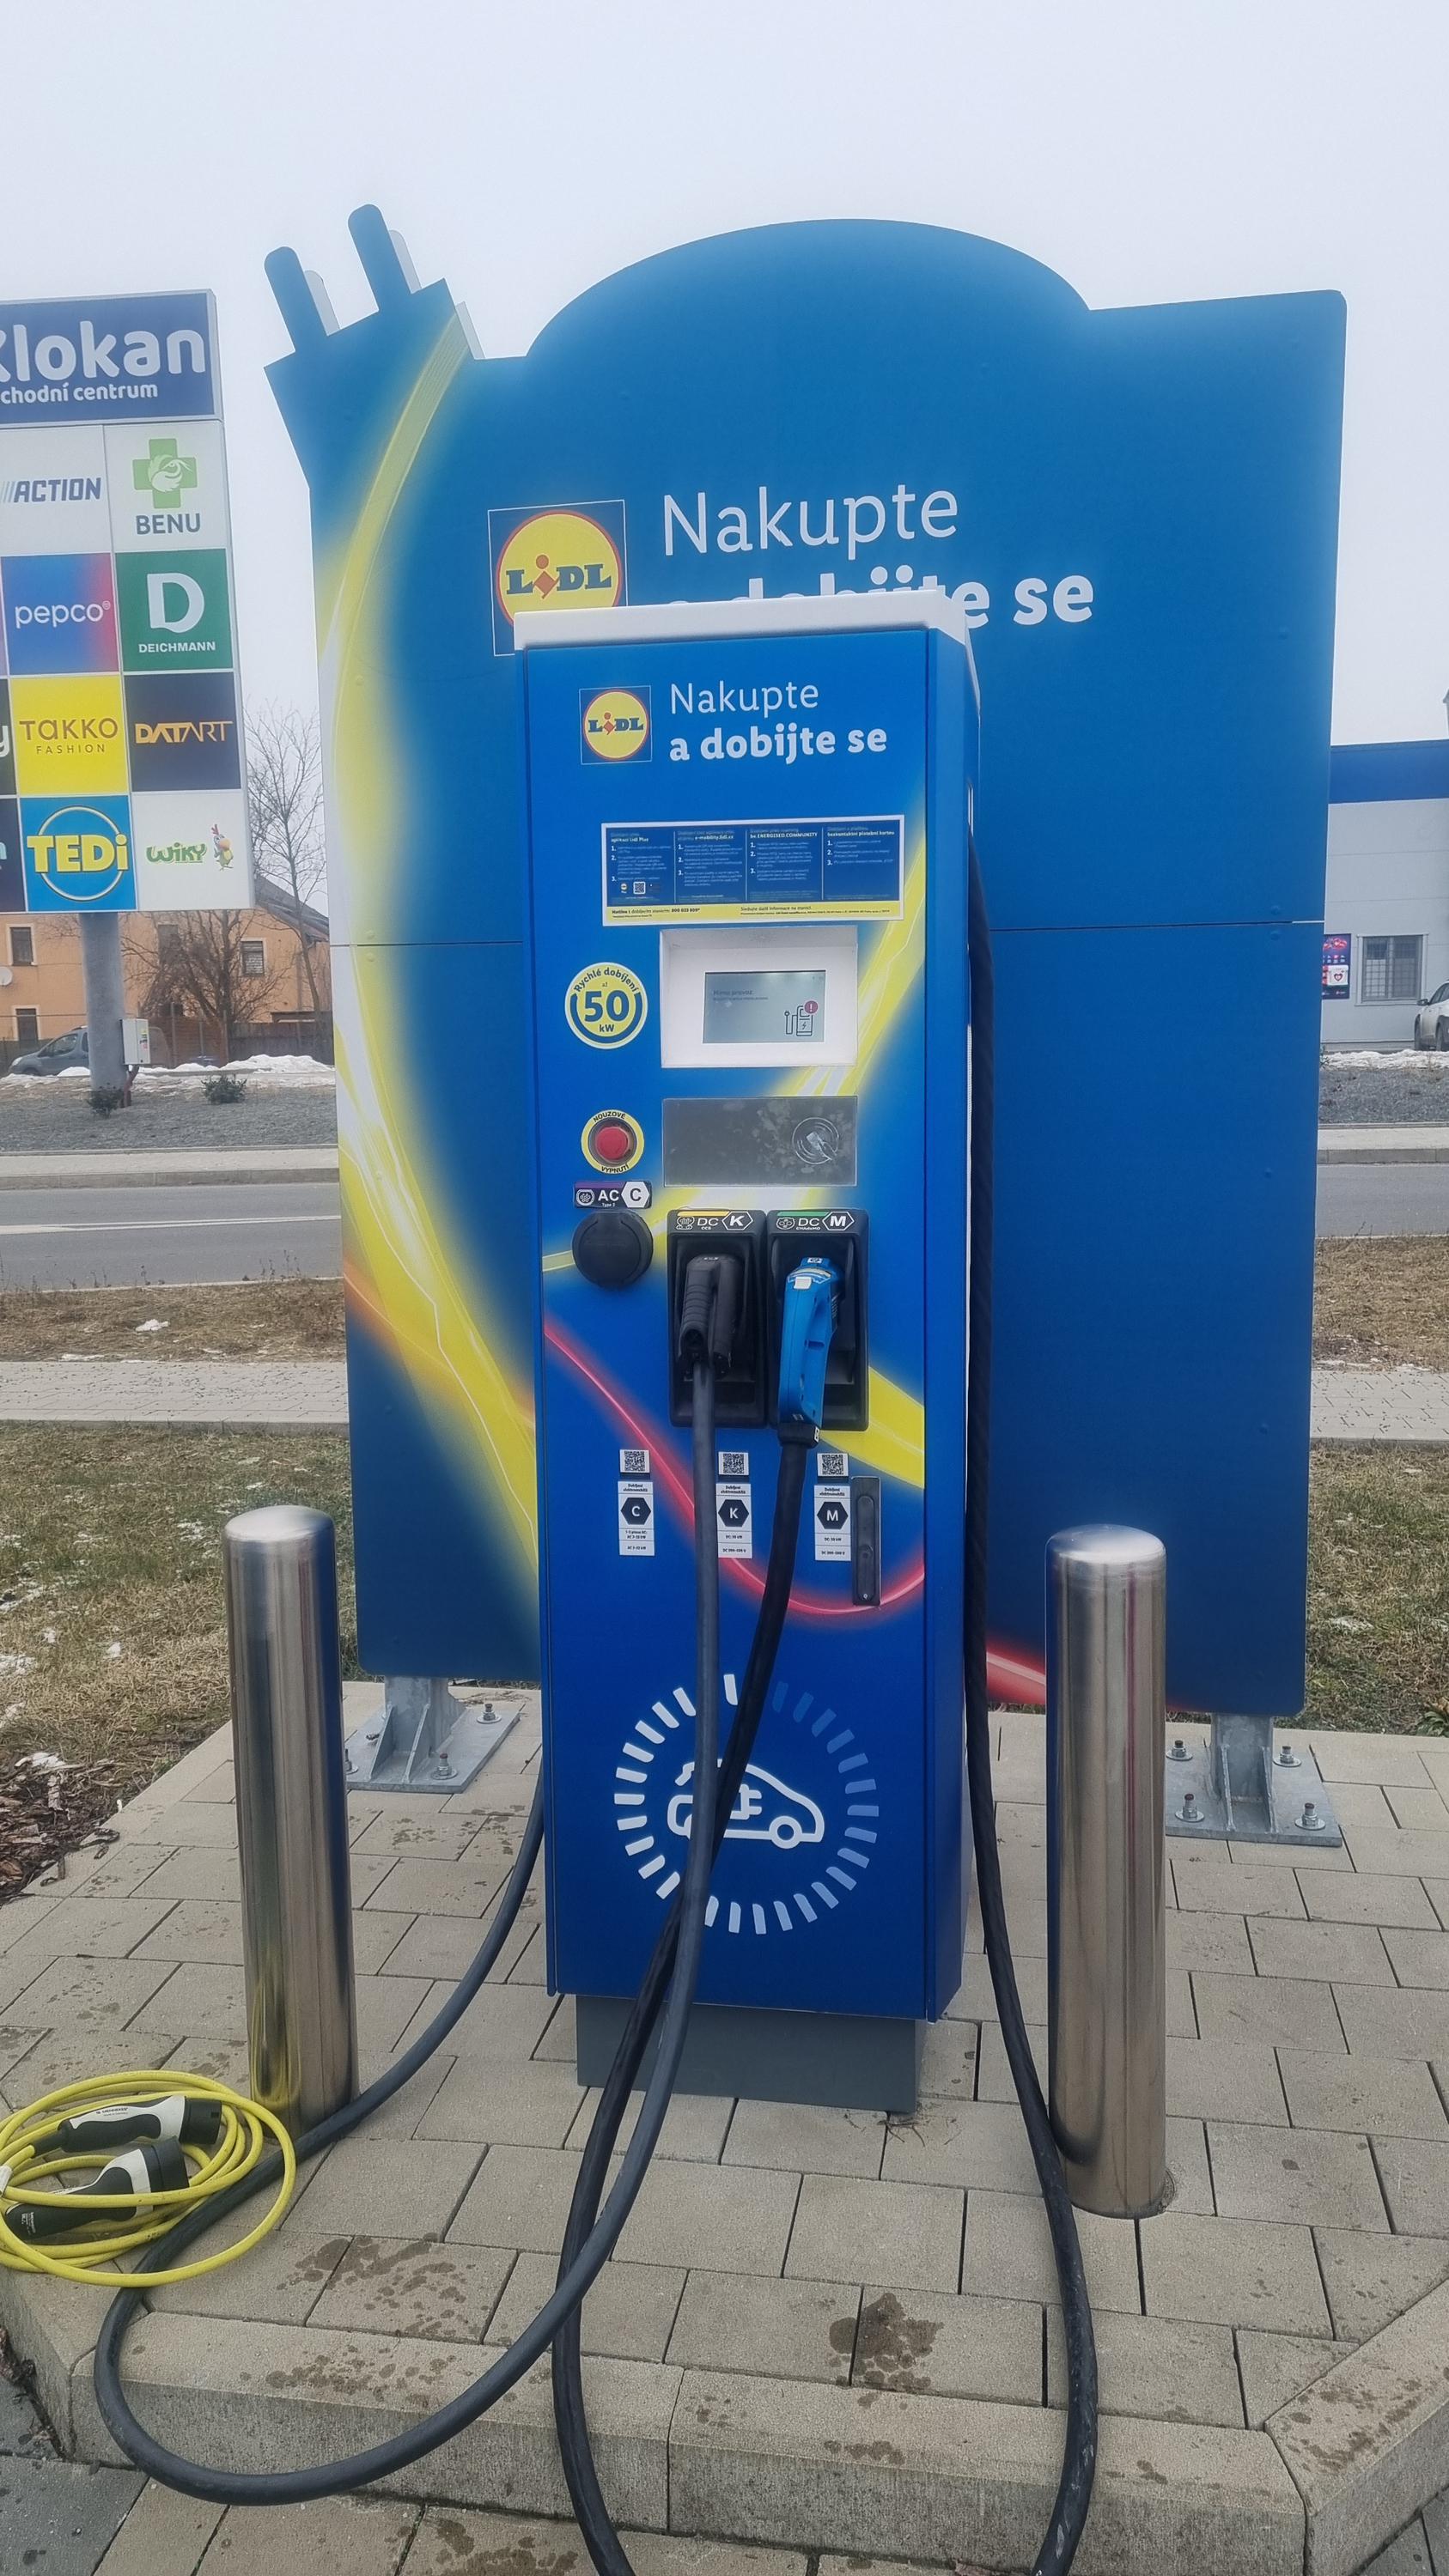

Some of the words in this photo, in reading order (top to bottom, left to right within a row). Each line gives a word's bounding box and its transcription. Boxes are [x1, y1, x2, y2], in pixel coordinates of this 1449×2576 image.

[73, 384, 158, 401] centrum
[13, 477, 102, 503] ACTION
[136, 513, 201, 535] BENU
[663, 483, 959, 560] Nakupte
[1013, 574, 1094, 625] se
[138, 641, 216, 653] DEICHMANN
[671, 680, 819, 719] Nakupte
[135, 720, 234, 744] DATART
[36, 744, 105, 754] FASHION
[669, 735, 691, 762] a
[700, 723, 836, 764] dobijte
[847, 727, 887, 754] se
[573, 968, 602, 993] Rychlé
[584, 989, 630, 1022] 50
[599, 1024, 615, 1032] kW
[598, 1189, 619, 1201] AC
[630, 1188, 642, 1201] C
[697, 1218, 719, 1226] DC
[729, 1215, 746, 1227] K
[798, 1218, 820, 1227] DC
[830, 1215, 846, 1227] M
[631, 1505, 641, 1517] C
[729, 1507, 739, 1519] K
[826, 1510, 839, 1522] M
